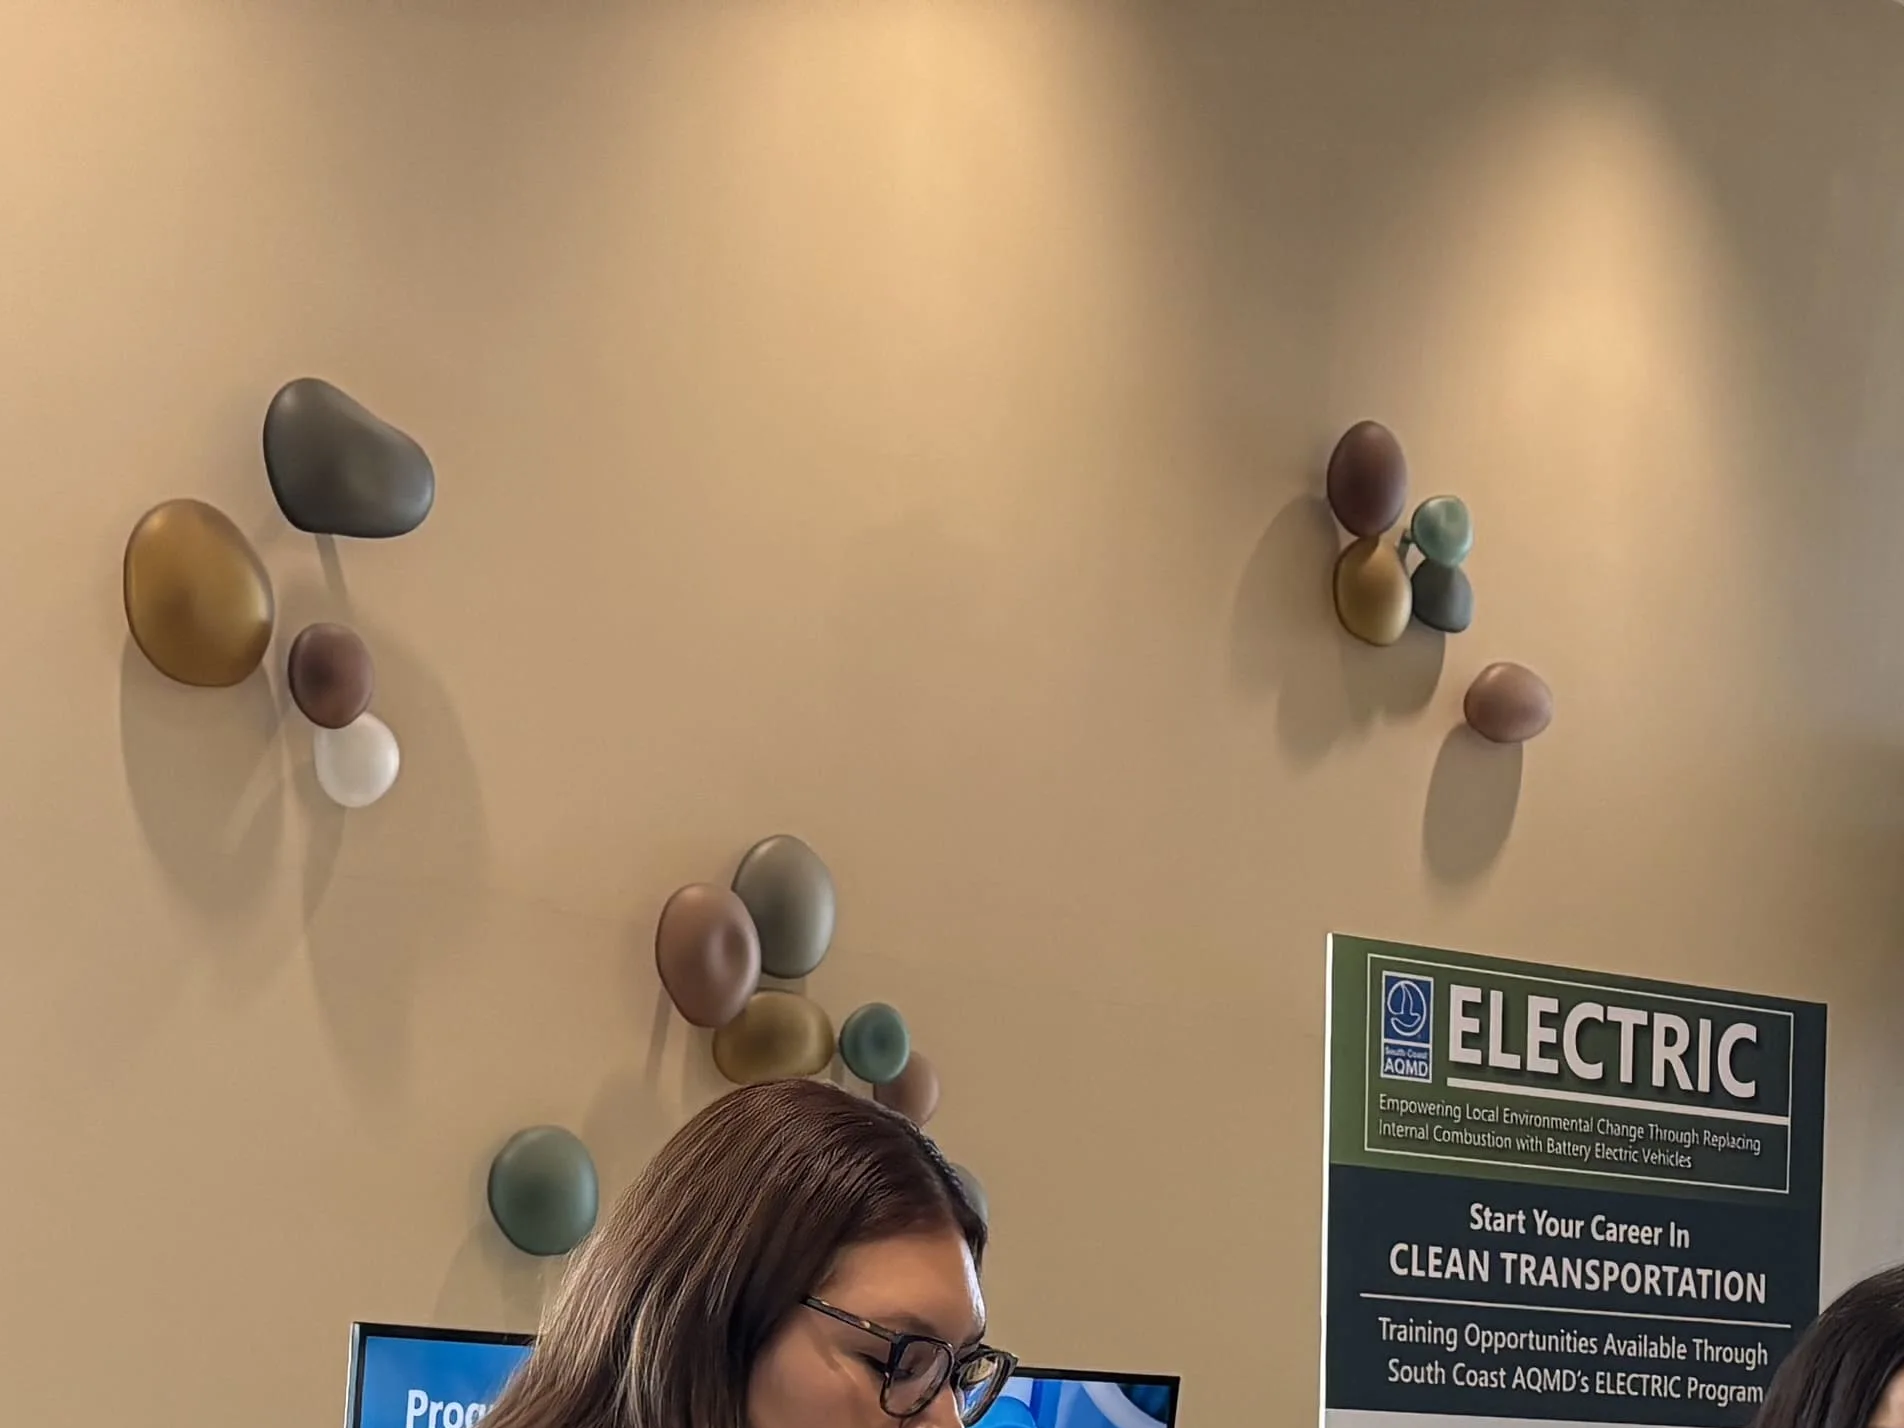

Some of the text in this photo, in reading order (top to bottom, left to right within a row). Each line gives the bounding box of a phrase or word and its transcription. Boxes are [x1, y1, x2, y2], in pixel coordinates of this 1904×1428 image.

[1448, 983, 1758, 1099] ELECTRIC
[1384, 1058, 1429, 1078] AQMD
[1378, 1092, 1761, 1156] Empowering Local Environmental Change Through Replacing
[1378, 1117, 1692, 1169] Internal Combustion with Battery Electric Vehicles
[1469, 1202, 1690, 1249] Start Your Career In
[1389, 1242, 1766, 1304] CLEAN TRANSPORTATION
[1377, 1316, 1768, 1371] Training Opportunities Available Through
[1387, 1357, 1767, 1407] South Coast AQMD's ELECTRIC Program
